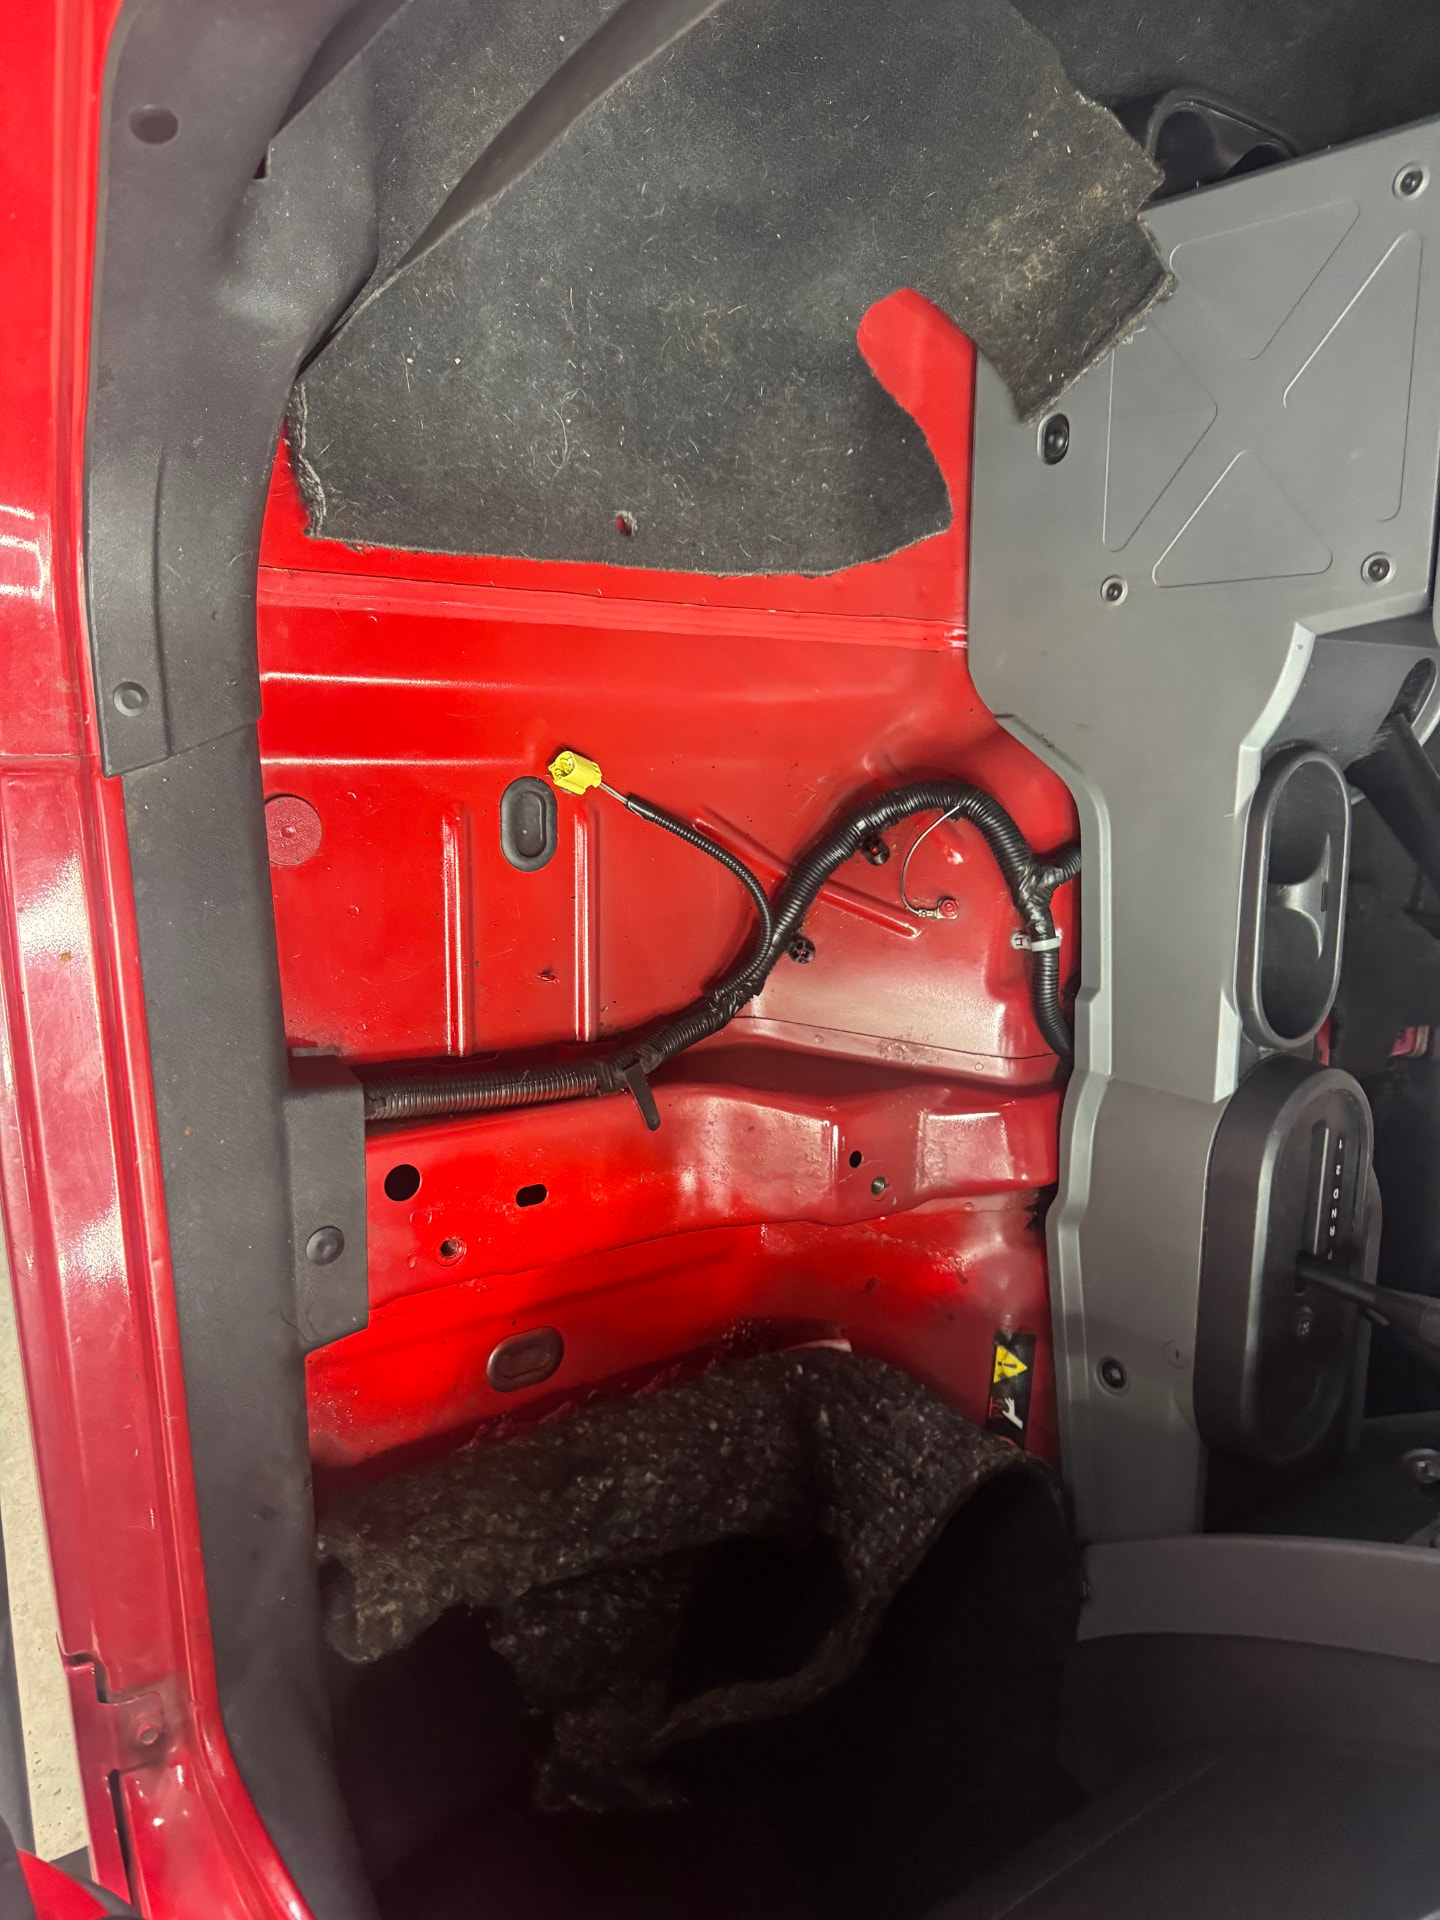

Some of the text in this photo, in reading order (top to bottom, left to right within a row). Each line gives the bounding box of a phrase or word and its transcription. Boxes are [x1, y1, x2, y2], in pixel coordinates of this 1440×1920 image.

[1338, 1138, 1343, 1150] 1
[1335, 1164, 1341, 1175] 2
[1331, 1207, 1338, 1219] N
[1329, 1225, 1336, 1237] R
